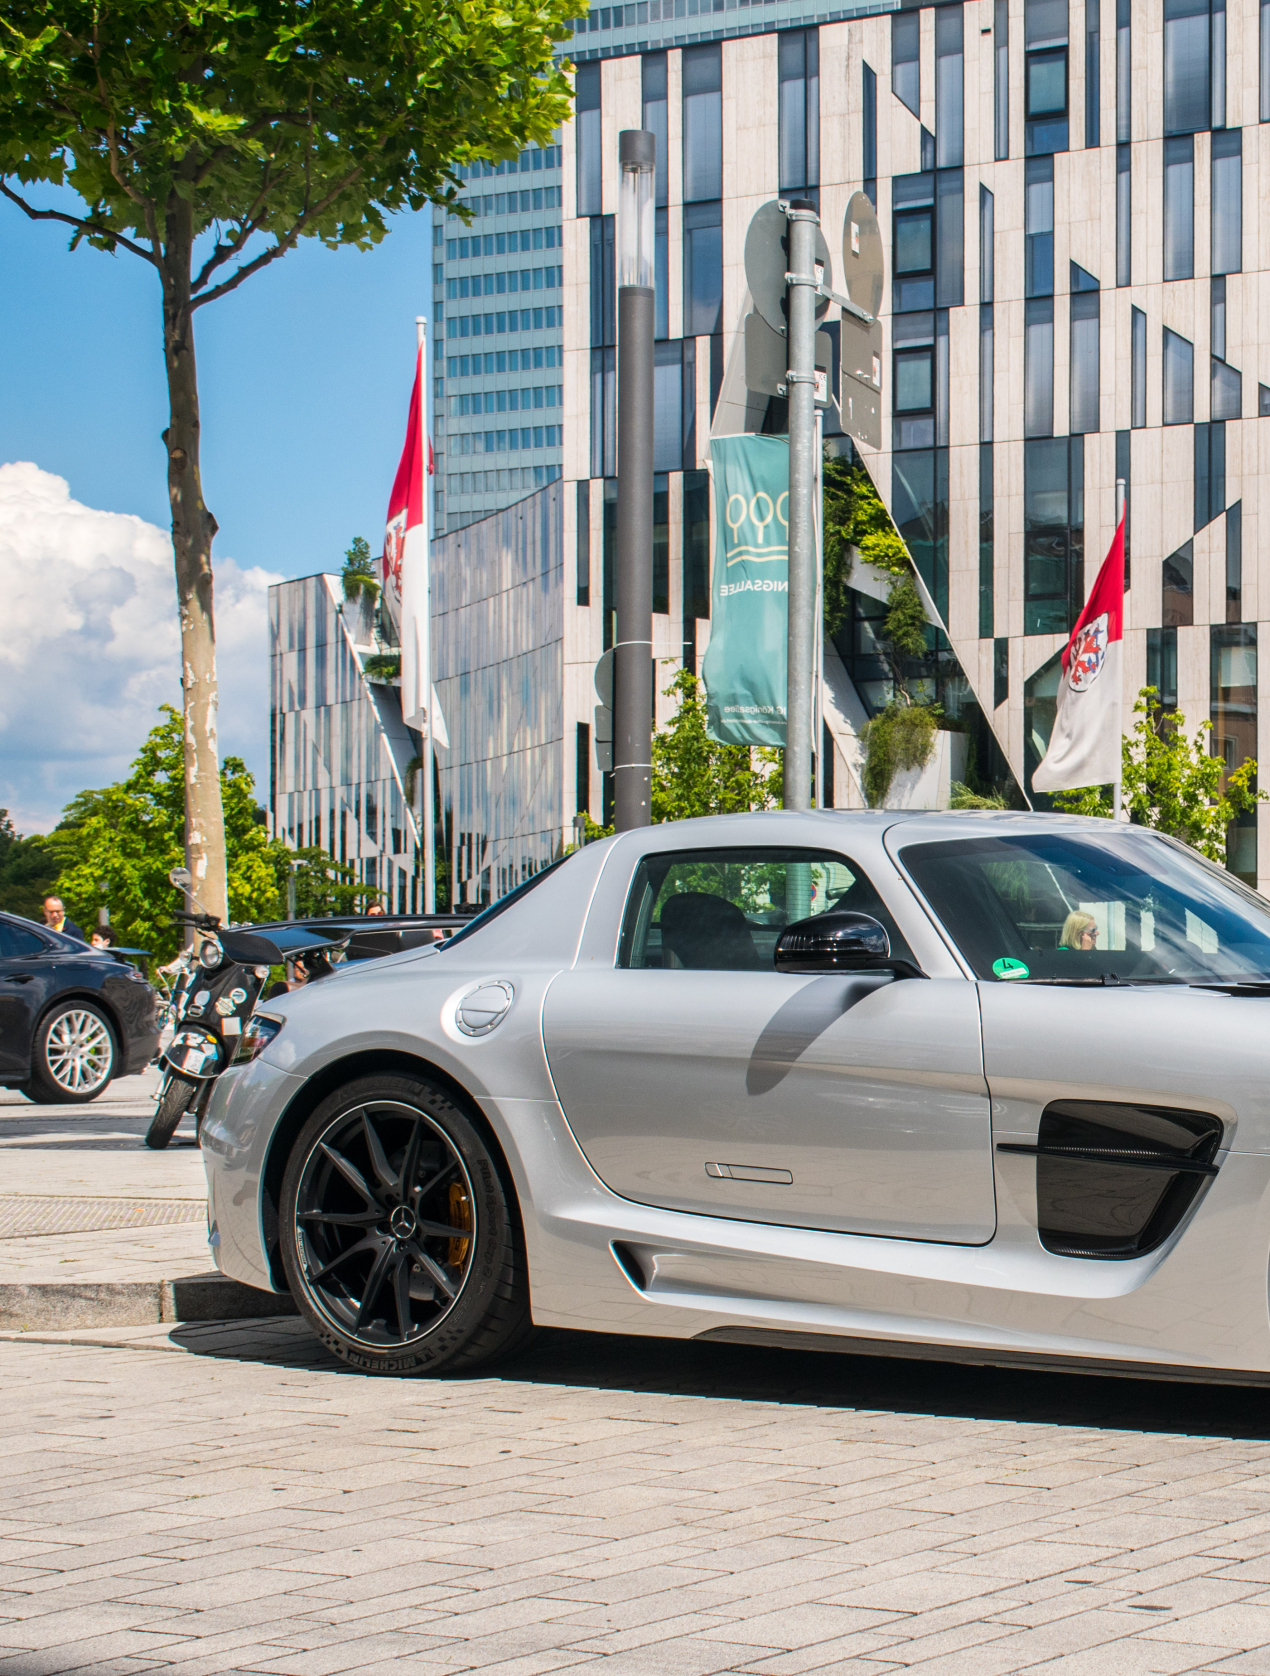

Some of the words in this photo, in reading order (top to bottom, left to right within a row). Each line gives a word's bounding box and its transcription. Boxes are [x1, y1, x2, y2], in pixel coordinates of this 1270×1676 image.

[1002, 958, 1014, 969] 4
[477, 1159, 494, 1193] Pilot
[347, 1349, 417, 1371] MICHELIN
